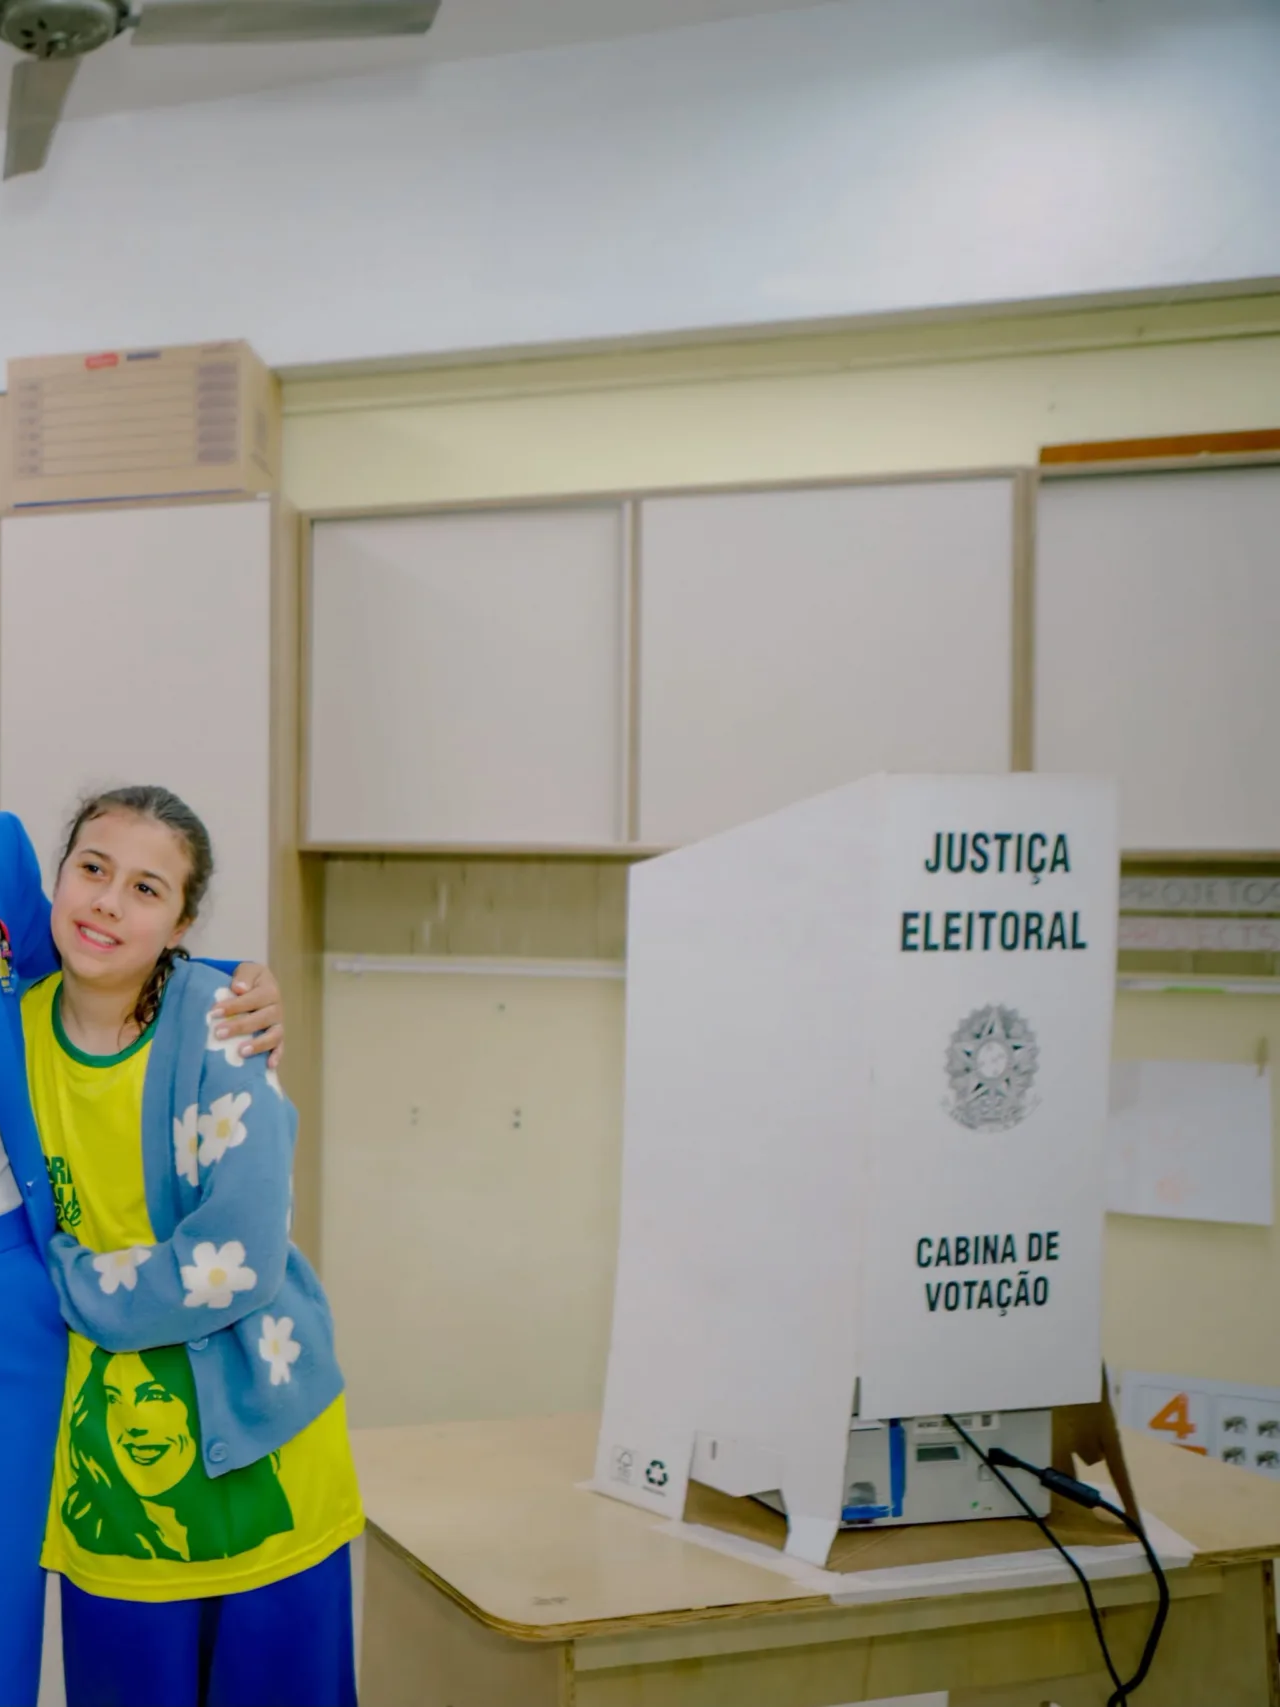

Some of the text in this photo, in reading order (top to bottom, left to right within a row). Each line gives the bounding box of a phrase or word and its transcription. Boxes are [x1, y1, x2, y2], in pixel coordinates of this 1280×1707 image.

[925, 832, 1071, 885] JUSTIÇA
[901, 911, 1087, 951] ELEITORAL
[916, 1231, 1060, 1268] CABINA DE
[926, 1270, 1049, 1317] VOTAÇÃO
[1149, 1392, 1196, 1440] 4
